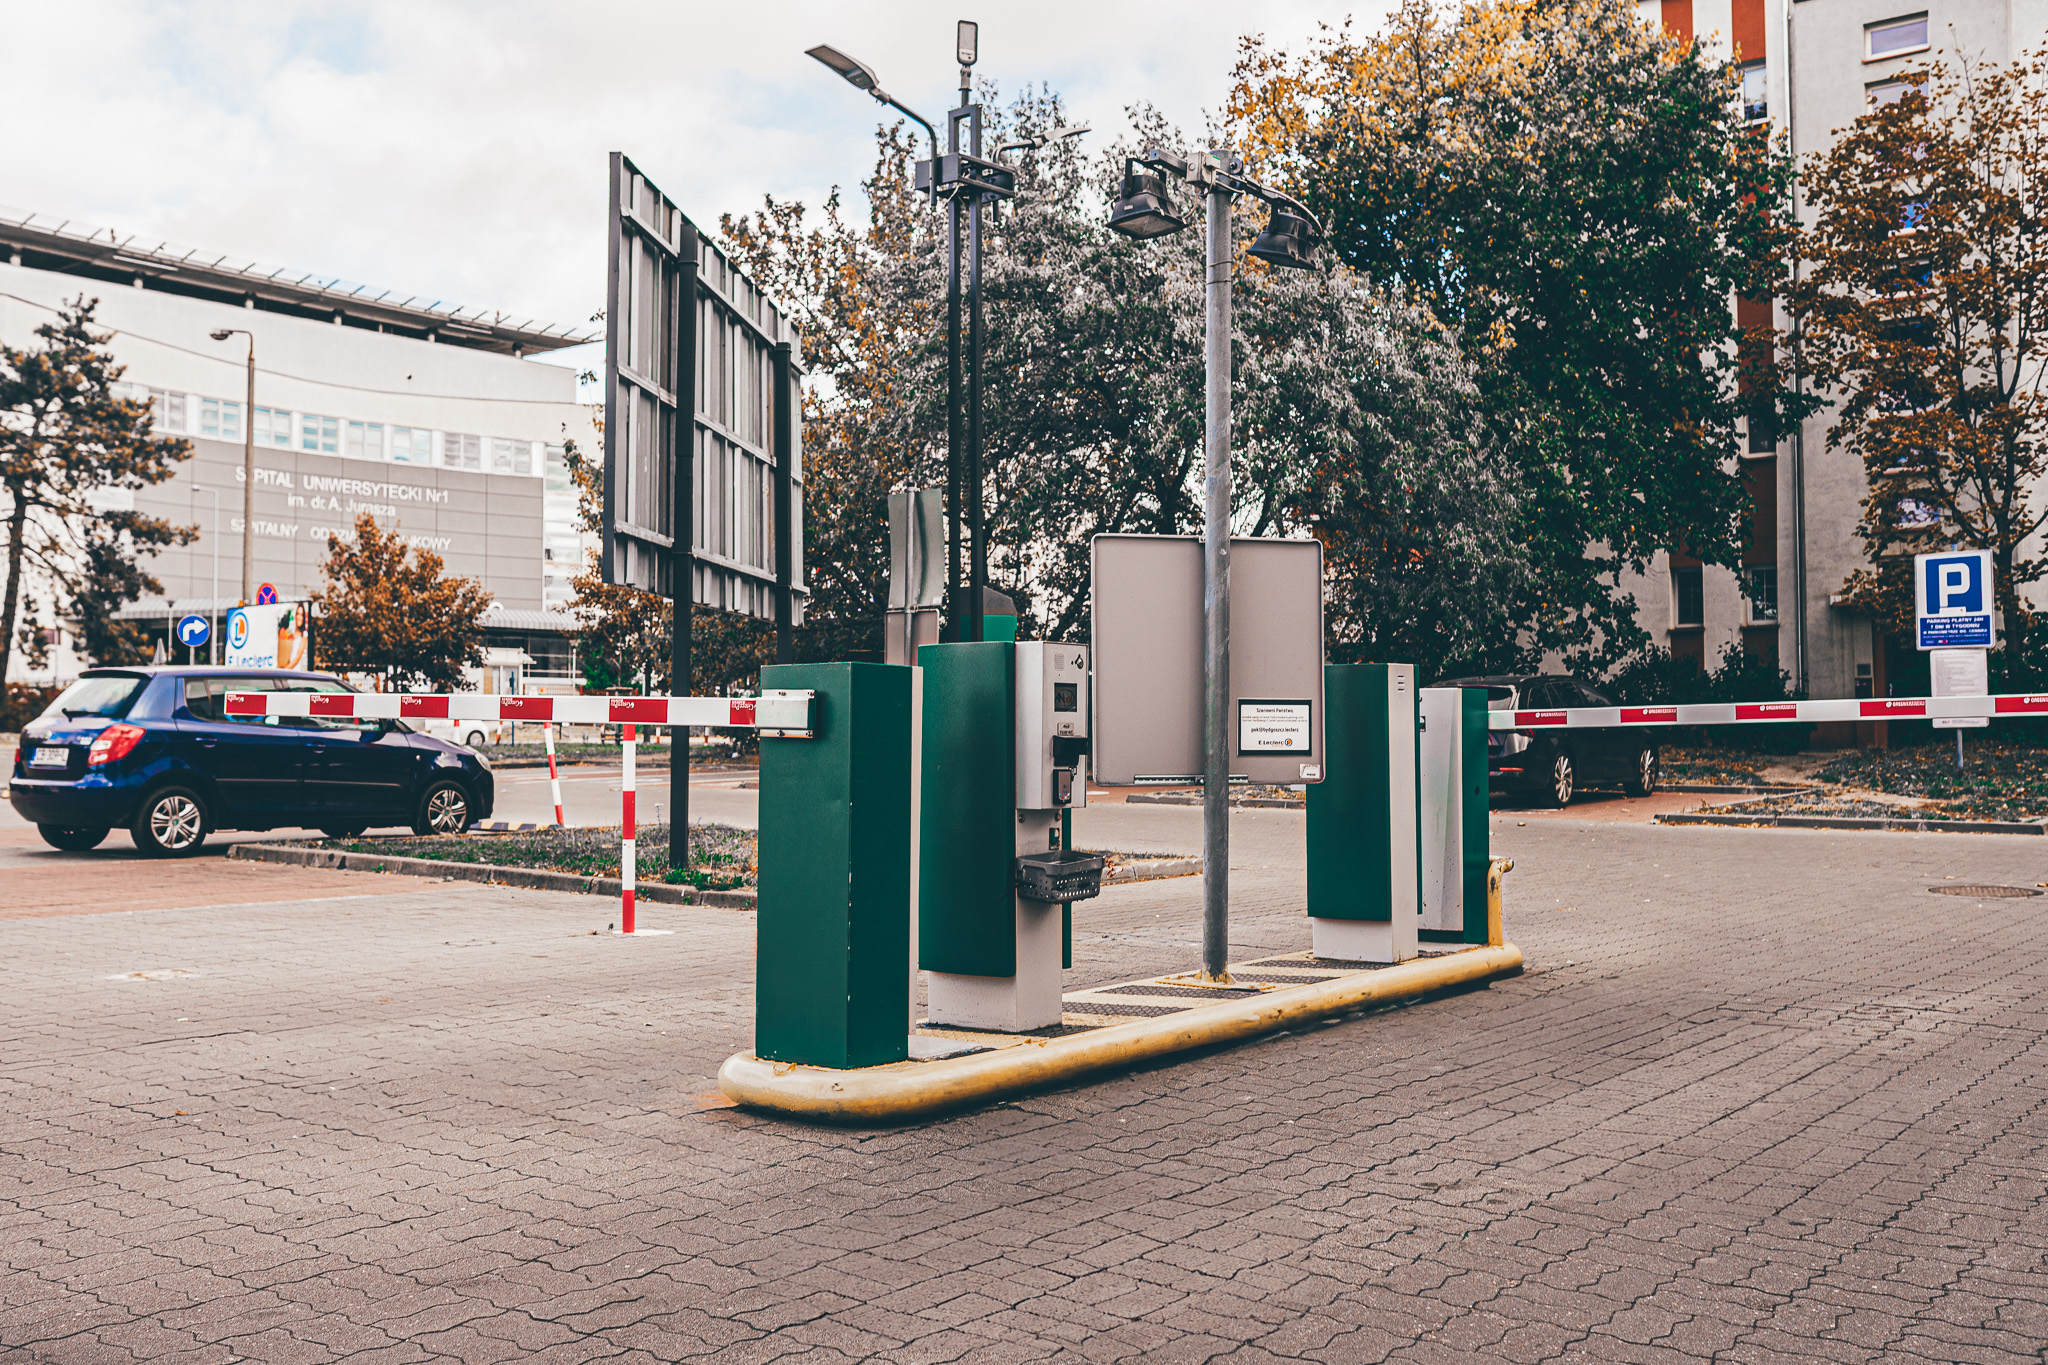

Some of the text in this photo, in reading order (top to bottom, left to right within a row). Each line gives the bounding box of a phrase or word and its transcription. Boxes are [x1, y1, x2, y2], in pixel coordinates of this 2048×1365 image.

[235, 465, 294, 489] SPITAL
[303, 474, 422, 502] UNIWERSYTECKI
[1939, 563, 1970, 607] P
